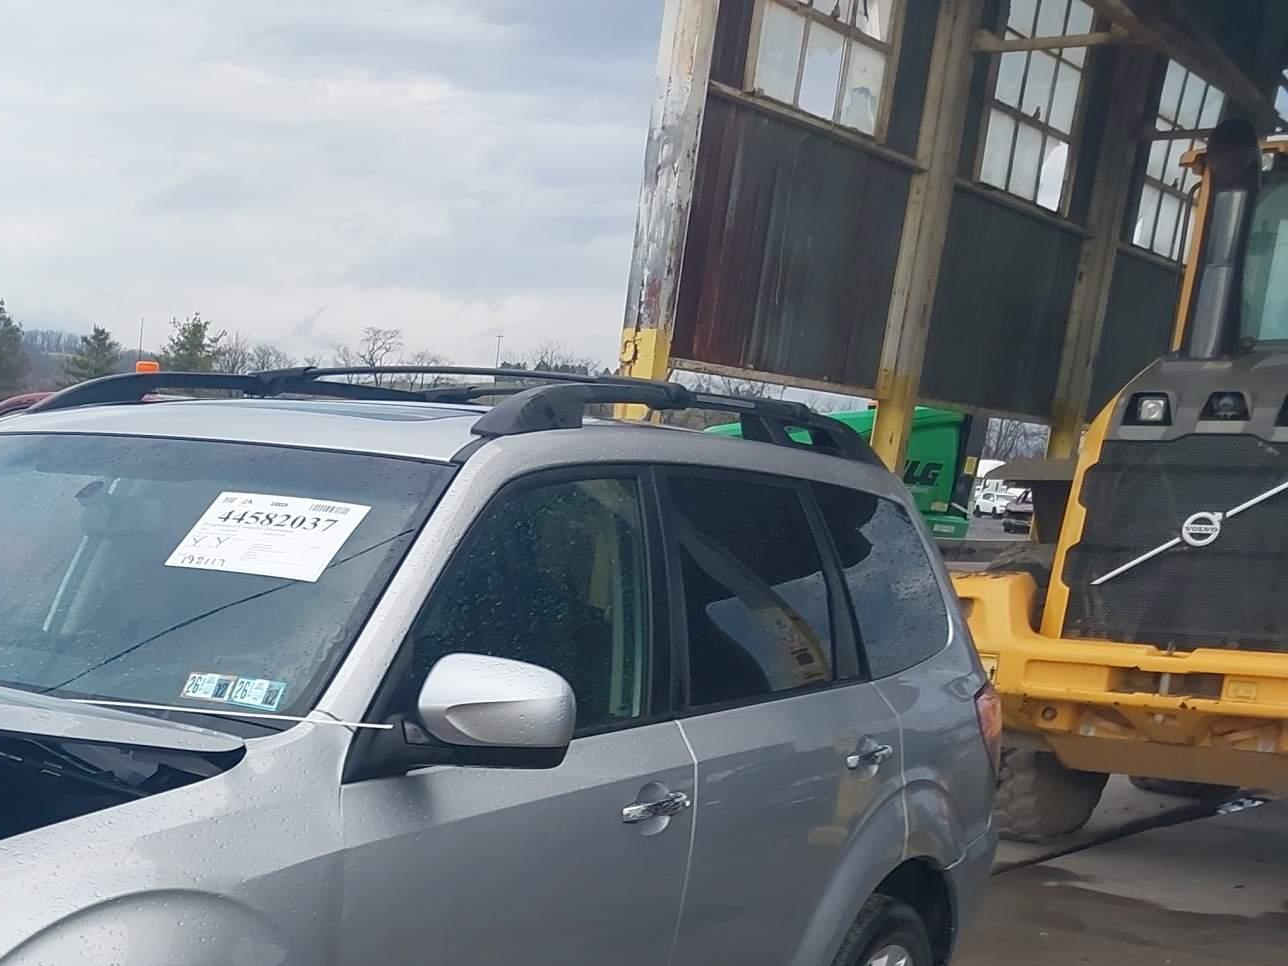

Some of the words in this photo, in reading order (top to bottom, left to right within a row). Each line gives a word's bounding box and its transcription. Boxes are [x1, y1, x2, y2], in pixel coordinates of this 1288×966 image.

[218, 510, 338, 532] 44582037
[186, 676, 202, 694] 26
[215, 682, 228, 698] 12
[234, 681, 251, 699] 26
[263, 690, 278, 705] 12
